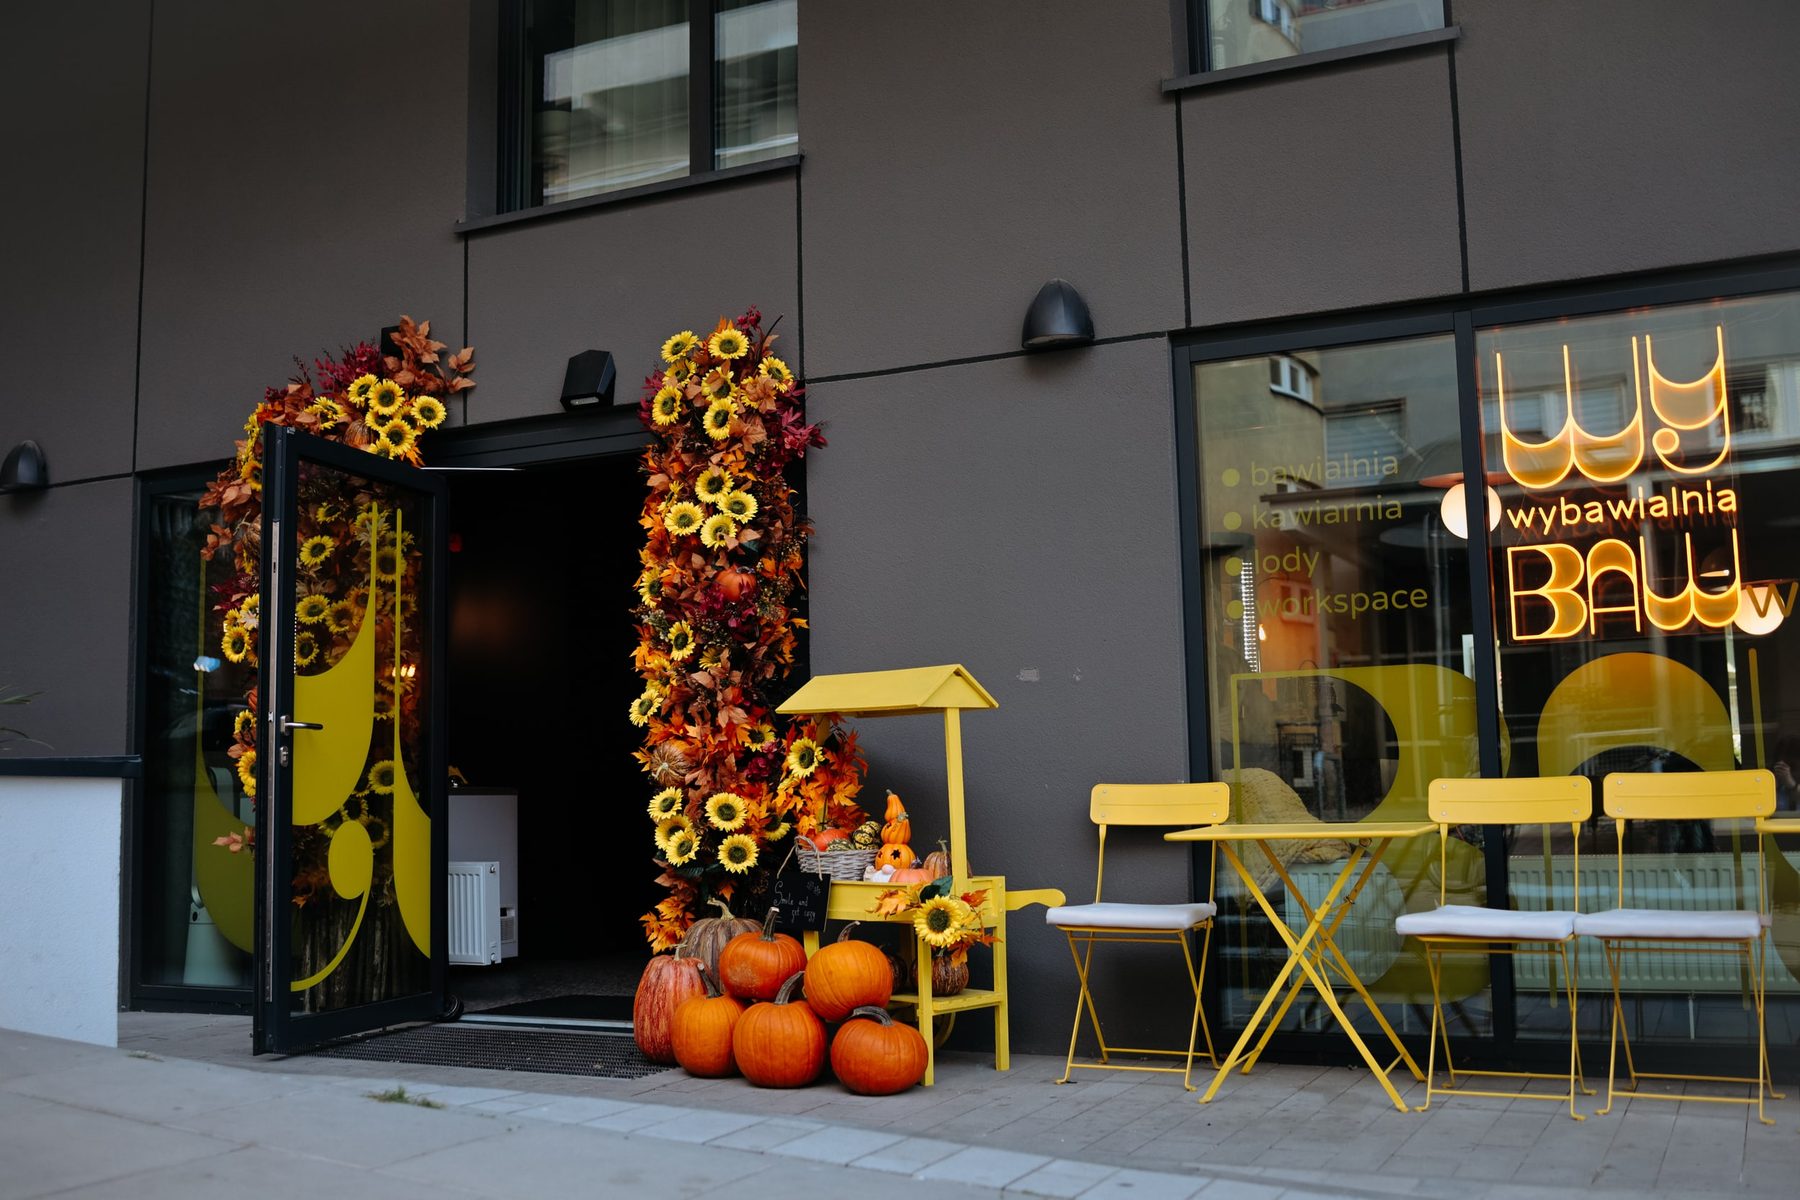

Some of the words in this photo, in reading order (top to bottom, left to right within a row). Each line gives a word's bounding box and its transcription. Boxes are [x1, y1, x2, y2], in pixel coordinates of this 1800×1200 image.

[1250, 450, 1400, 487] bawialnia
[1252, 494, 1403, 530] kawiarnia
[1506, 479, 1738, 535] wybawialnia
[1254, 546, 1320, 578] lody
[1506, 528, 1742, 640] BAW
[1256, 587, 1429, 620] workspace
[773, 880, 794, 906] Smile
